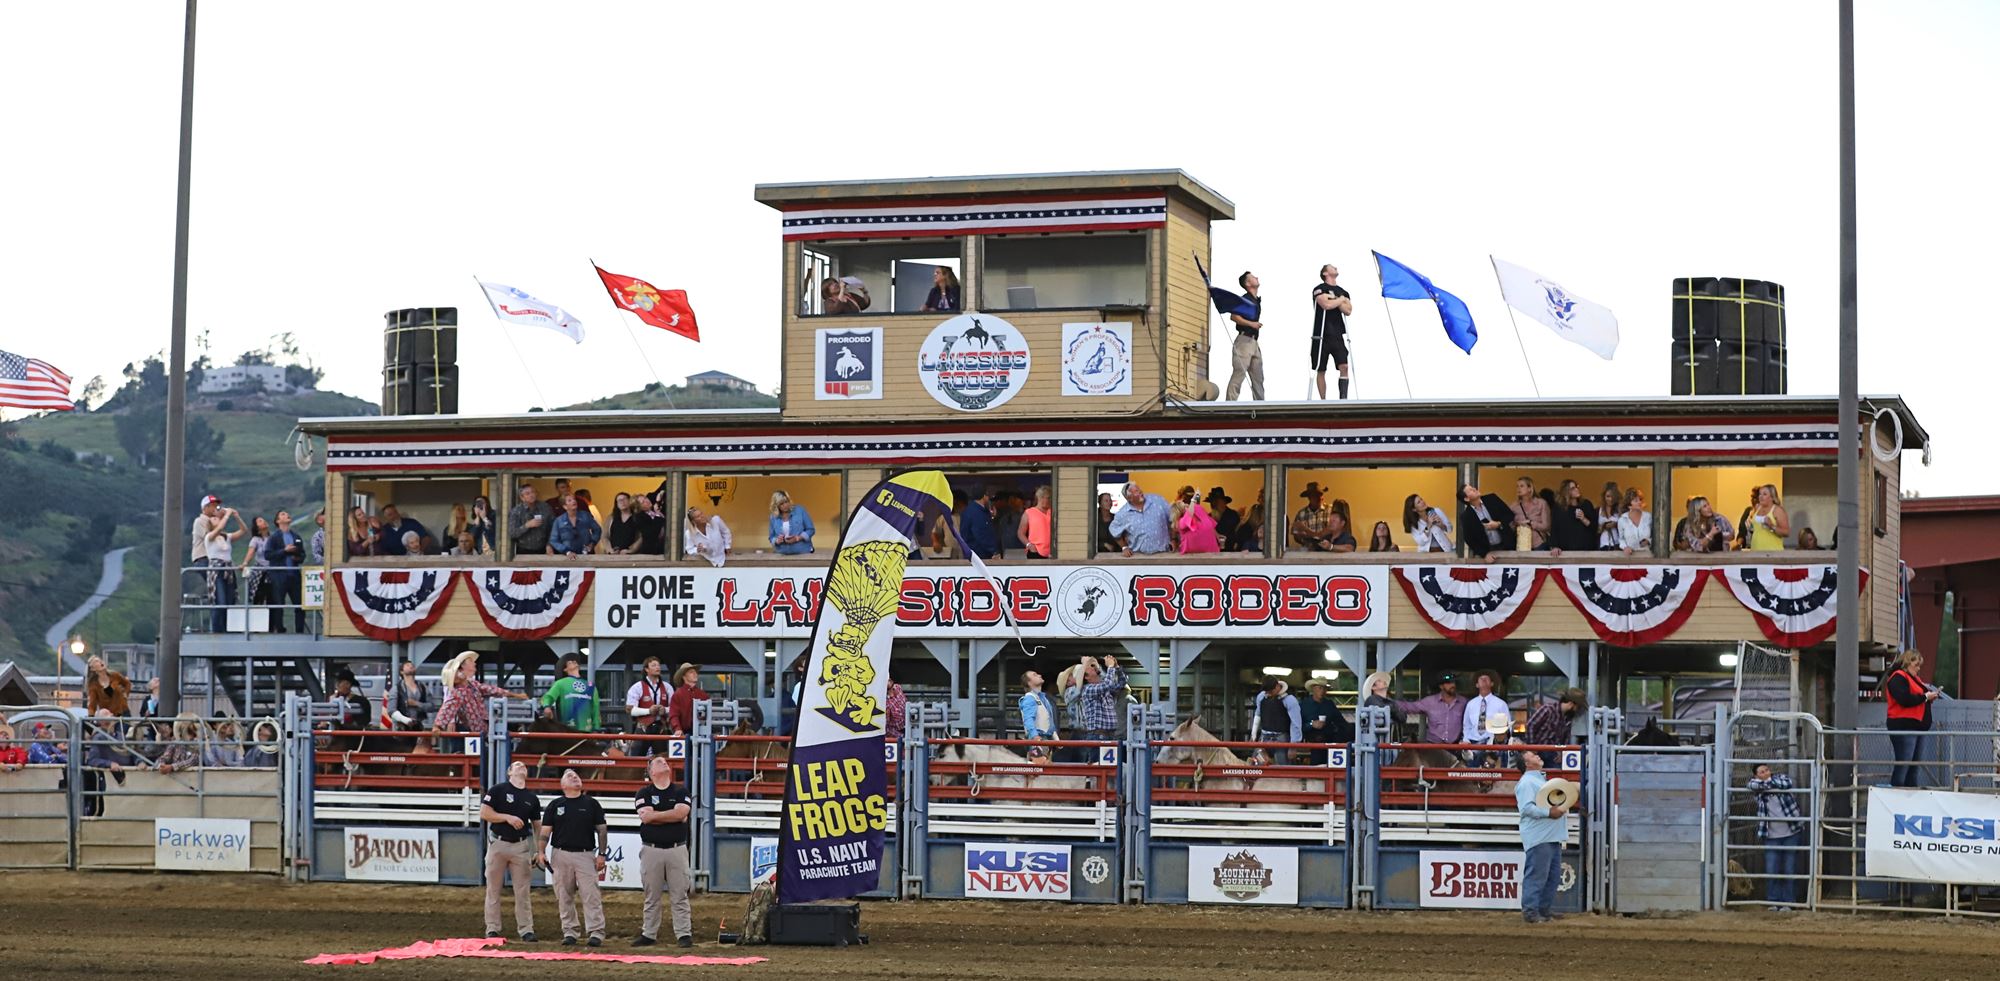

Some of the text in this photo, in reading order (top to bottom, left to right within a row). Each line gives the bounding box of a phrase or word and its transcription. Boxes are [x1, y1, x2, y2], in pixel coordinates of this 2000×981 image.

[921, 350, 1026, 371] LAKESIDE
[938, 370, 1010, 390] RODEO
[622, 575, 694, 599] HOME
[715, 575, 1371, 626] LASIDE RODEO
[608, 604, 705, 628] OF THE
[468, 739, 478, 754] 1
[672, 742, 683, 756] 2
[885, 745, 895, 759] 3
[1102, 748, 1115, 763] 4
[1332, 751, 1344, 765] 5
[1566, 753, 1578, 768] 6
[793, 758, 866, 801] LEAP
[788, 794, 887, 841] FROGS
[1894, 813, 1995, 840] KUSI
[159, 828, 246, 852] Parkway
[1893, 840, 1922, 850] SAN
[1927, 843, 1982, 854] DIEGO'S
[175, 851, 225, 861] PLAZA
[348, 834, 436, 869] BARONA
[797, 847, 827, 866] U.S.
[828, 840, 868, 863] NAVY
[967, 850, 1068, 872] KUSI
[800, 859, 876, 880] PARACHUTE TEAM
[1218, 868, 1266, 878] MOUNTAIN
[1463, 862, 1518, 880] BOOT
[967, 872, 1068, 894] NEWS
[1463, 881, 1518, 899] BARN
